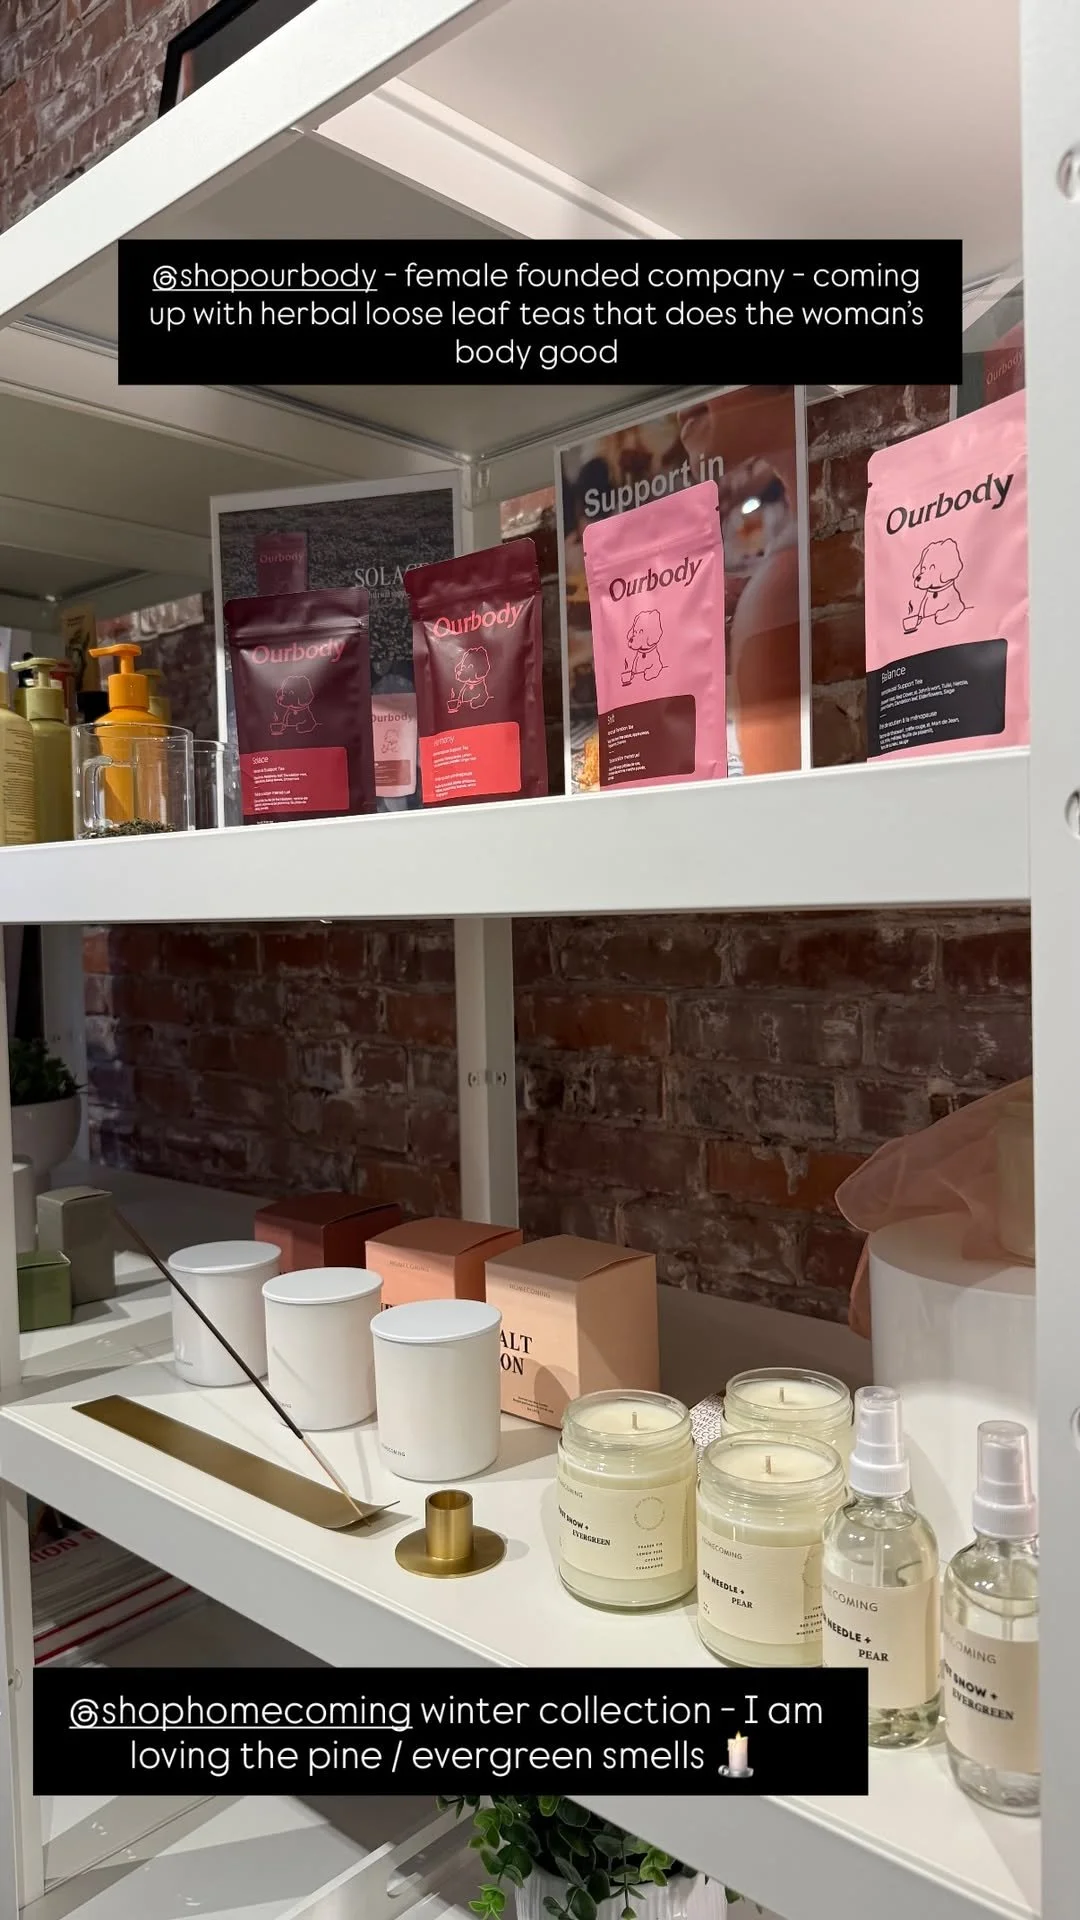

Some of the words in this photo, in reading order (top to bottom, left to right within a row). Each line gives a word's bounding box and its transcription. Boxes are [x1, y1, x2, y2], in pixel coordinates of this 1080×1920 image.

[584, 458, 692, 517] Support
[700, 453, 724, 481] in
[886, 472, 1014, 535] Ourbody
[259, 552, 305, 564] Ourbody
[354, 562, 431, 588] SOLA
[609, 556, 703, 602] Ourbody
[433, 602, 524, 638] Ourbody
[252, 639, 347, 664] Ourbody
[572, 1529, 611, 1546] EVERGREEN
[711, 1576, 738, 1594] NEEDLE
[731, 1596, 753, 1609] PEAR
[827, 1618, 862, 1643] NEEDLE
[858, 1648, 889, 1662] PEAR
[953, 1672, 987, 1698] SNOW
[952, 1687, 1014, 1721] EVERGREEN
